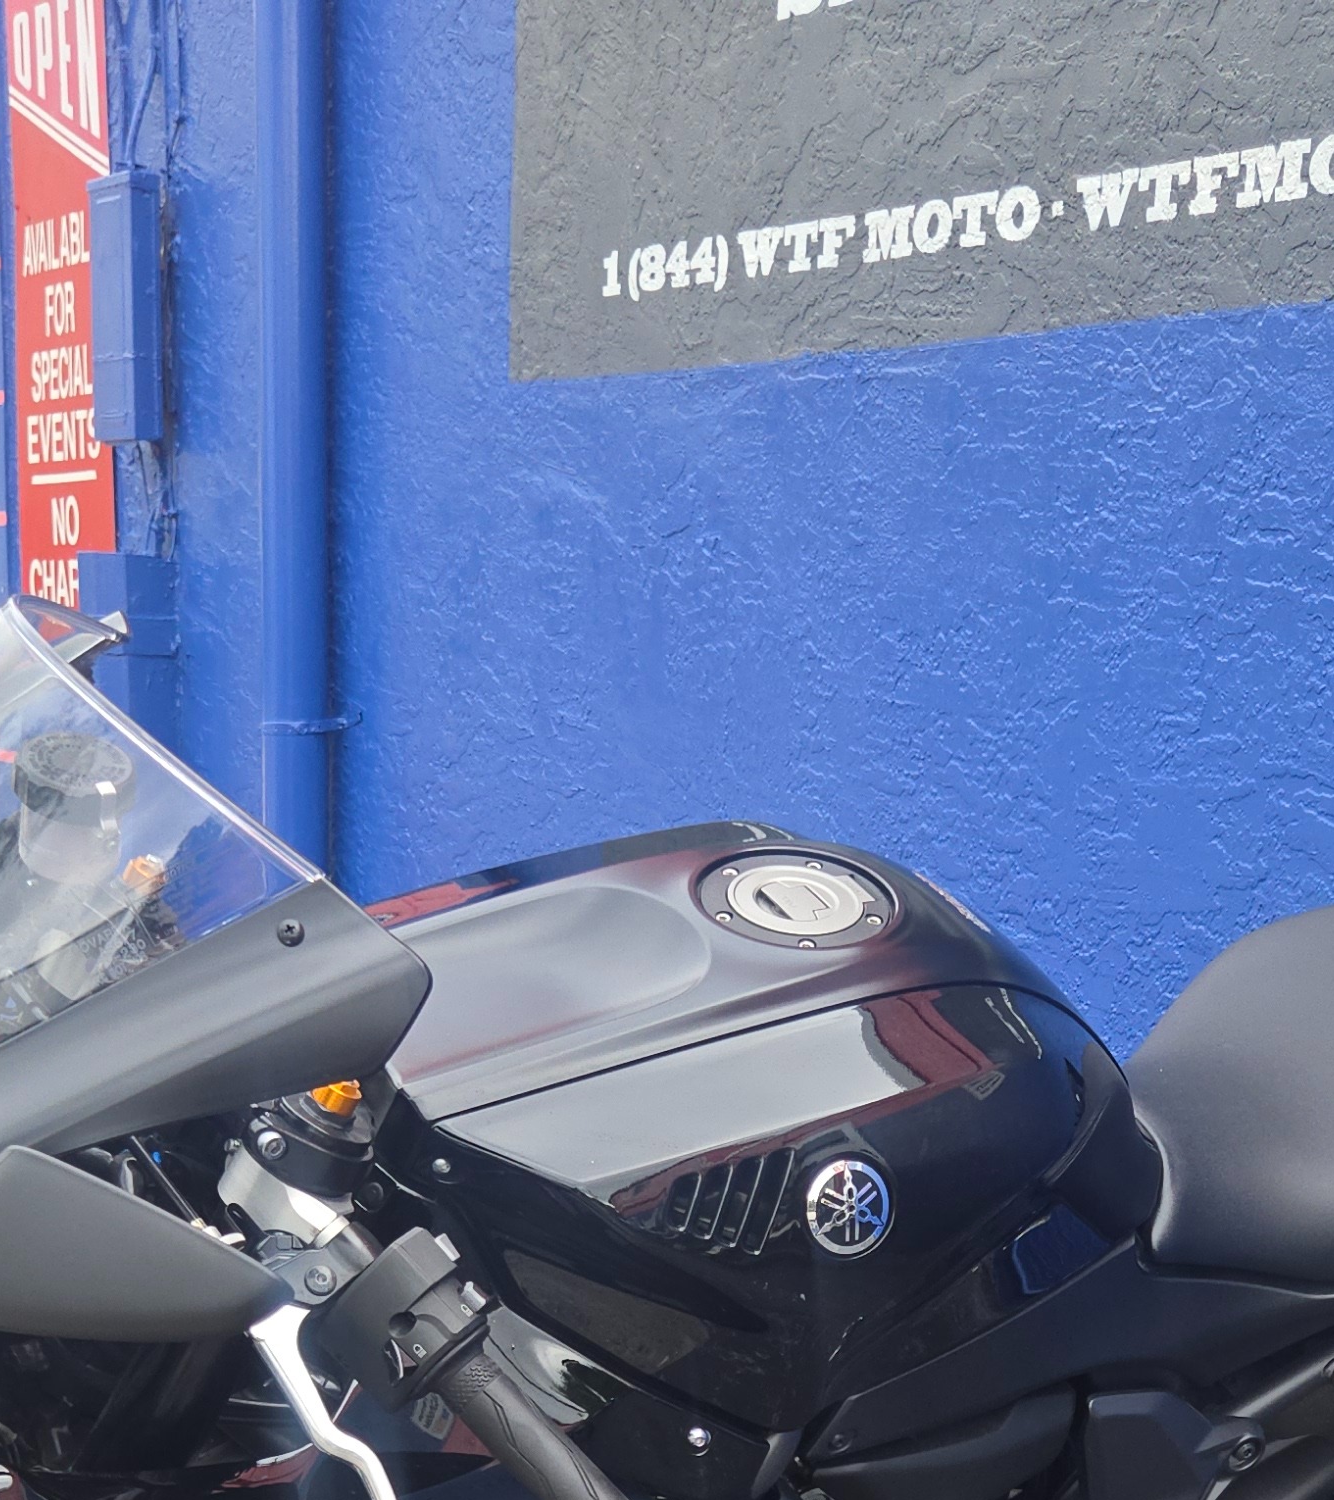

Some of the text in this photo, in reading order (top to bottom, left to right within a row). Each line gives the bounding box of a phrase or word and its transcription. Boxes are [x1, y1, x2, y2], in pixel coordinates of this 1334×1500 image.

[12, 0, 101, 140] OPEN
[601, 234, 729, 302] 1(844)
[735, 214, 857, 279] WTF
[861, 184, 1042, 264] MOTO
[44, 280, 76, 338] FOR
[31, 342, 94, 403] SPECIAL
[27, 407, 101, 465] EVENTS
[51, 494, 80, 546] NO
